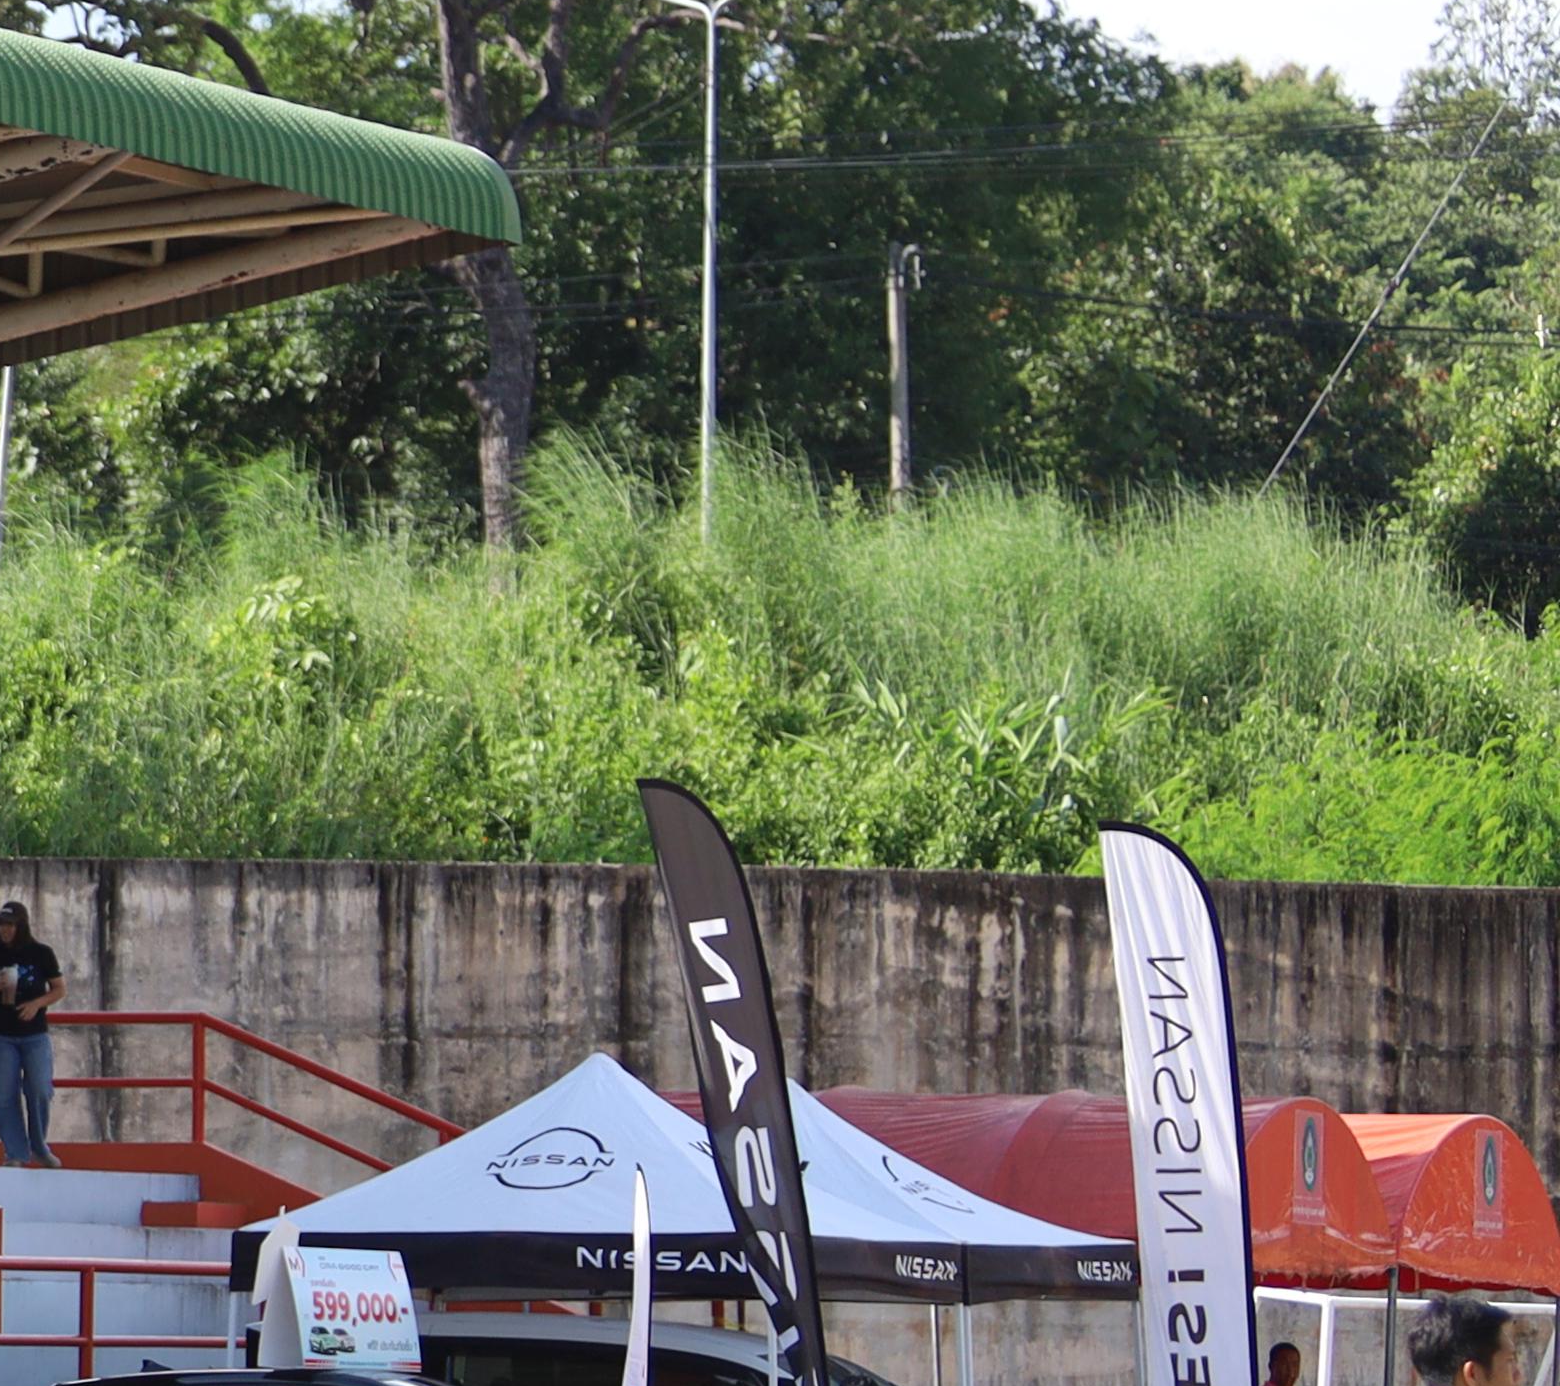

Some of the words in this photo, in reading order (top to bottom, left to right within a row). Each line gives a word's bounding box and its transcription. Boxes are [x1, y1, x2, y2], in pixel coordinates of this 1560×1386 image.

[486, 1154, 615, 1171] NISSAN
[895, 1254, 958, 1281] NISSAN
[1077, 1260, 1133, 1282] NISSAN
[312, 1291, 408, 1326] 599,000.-
